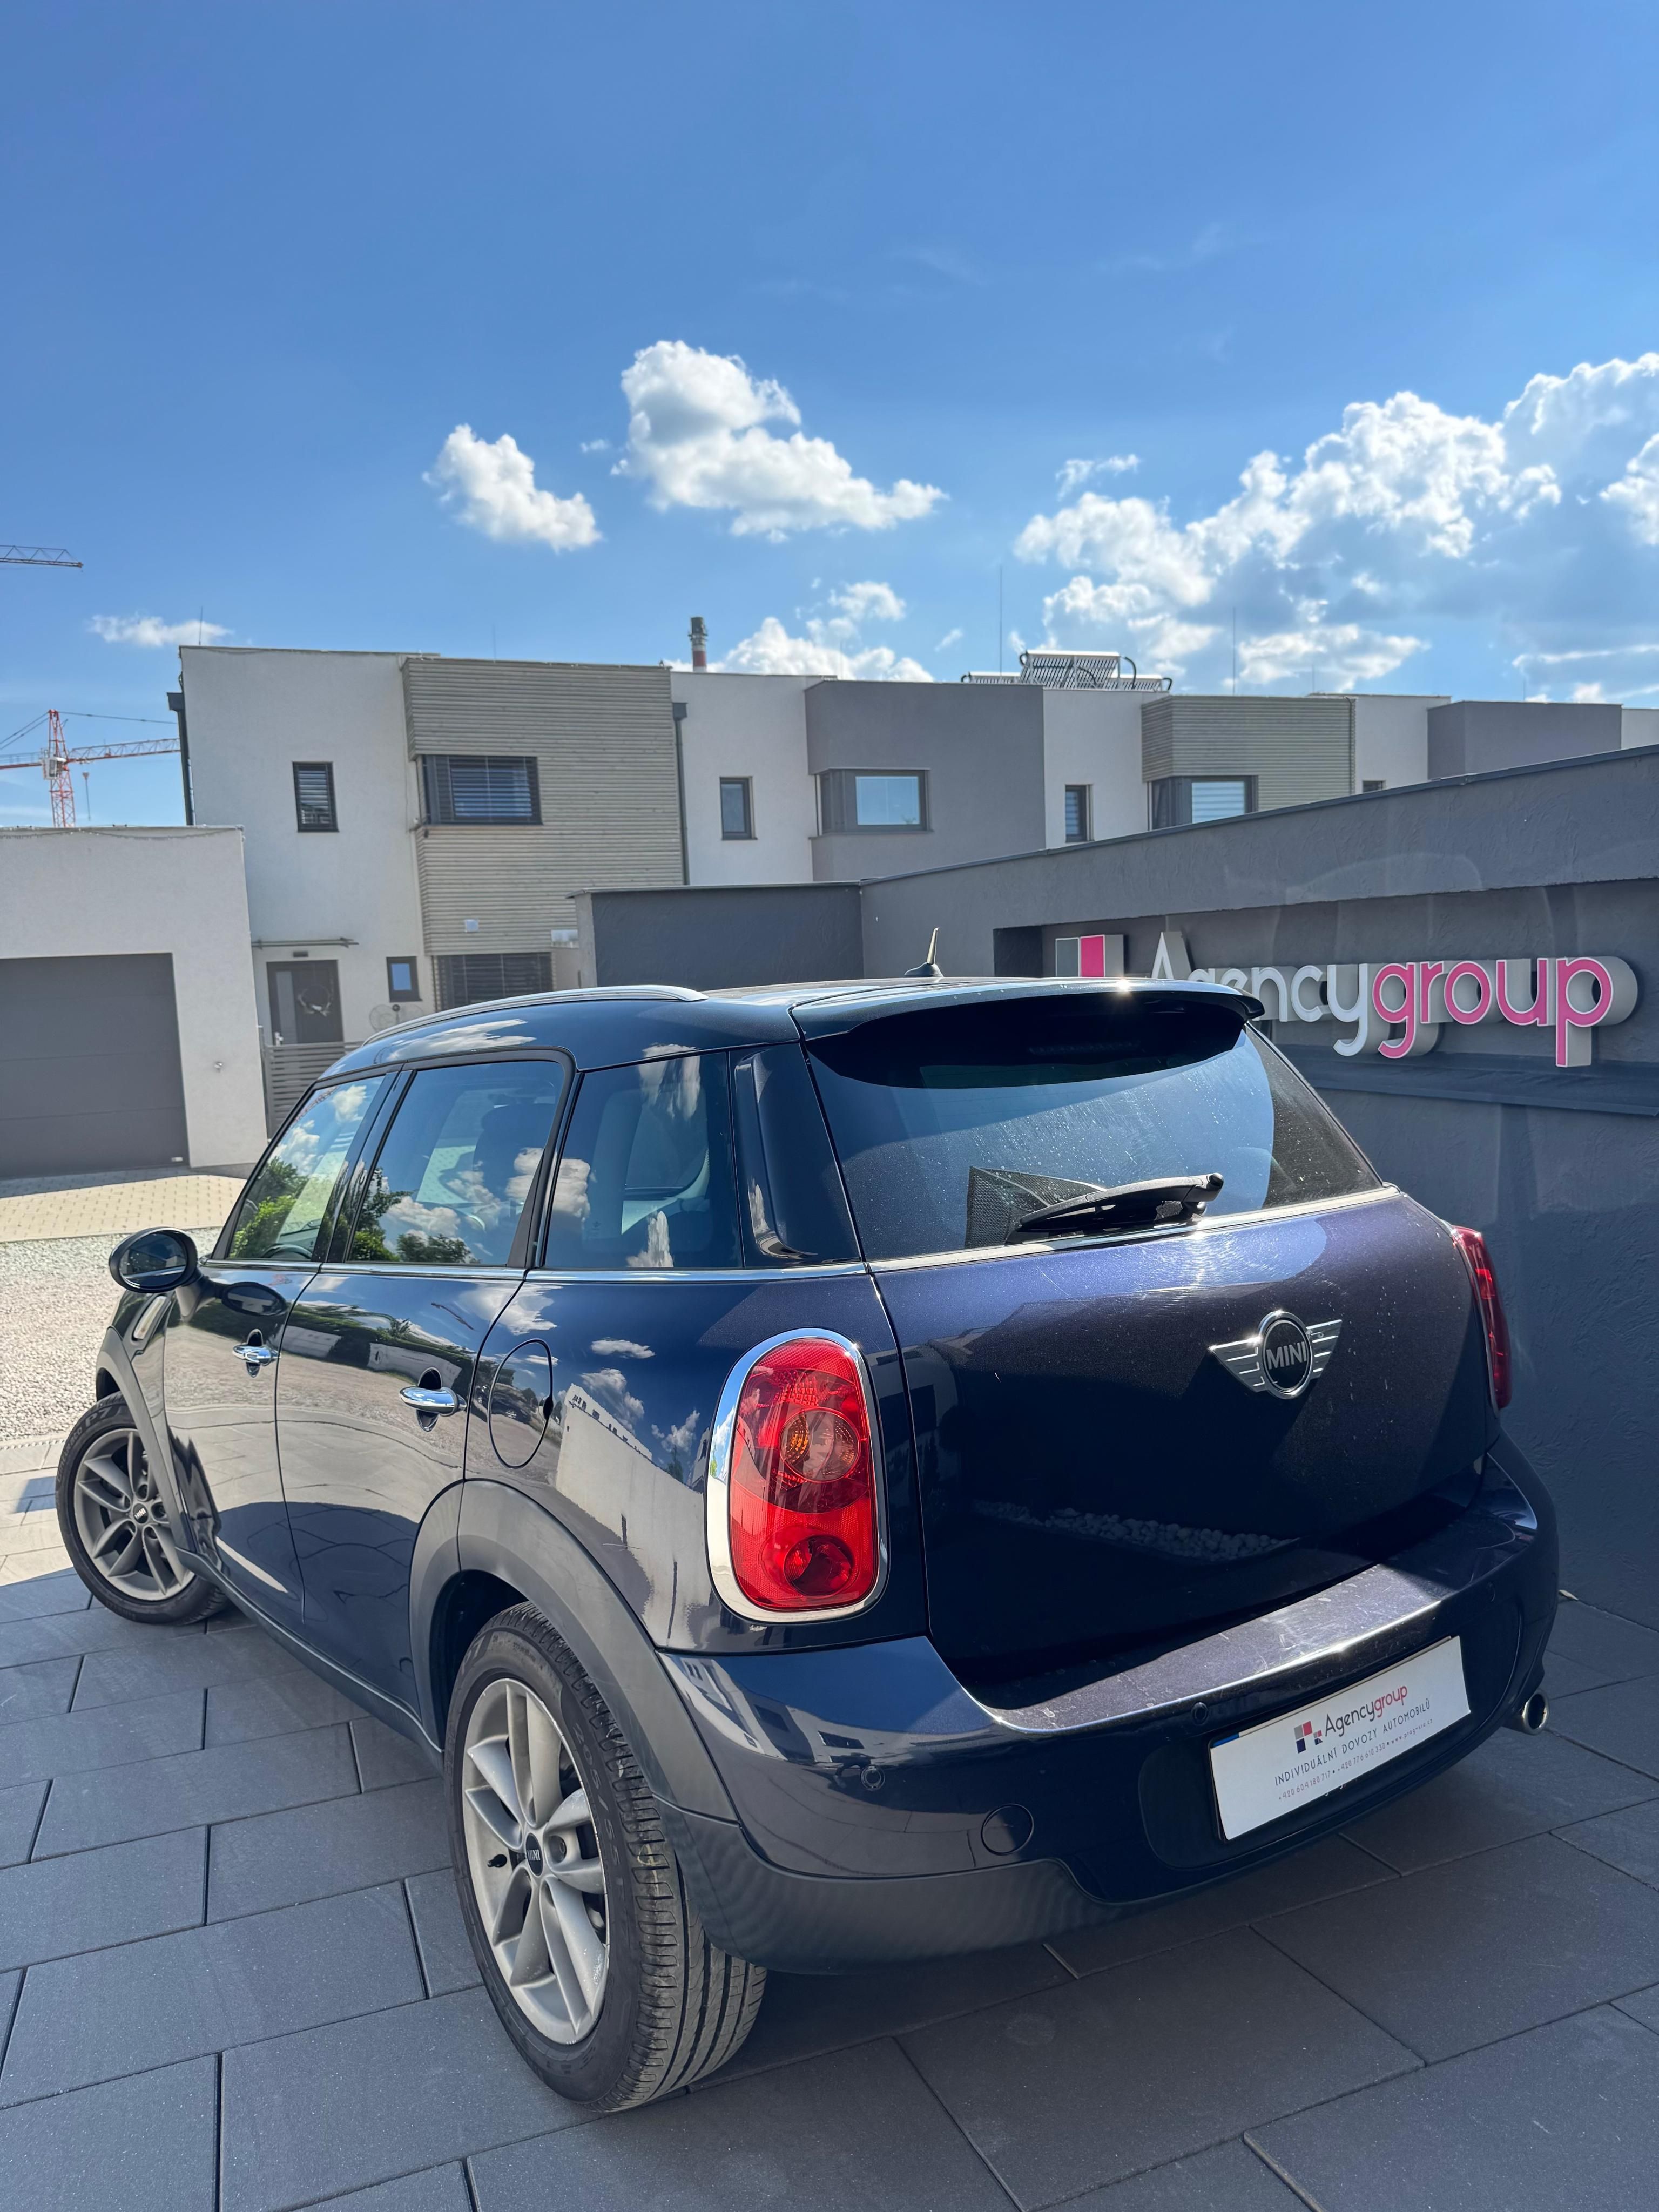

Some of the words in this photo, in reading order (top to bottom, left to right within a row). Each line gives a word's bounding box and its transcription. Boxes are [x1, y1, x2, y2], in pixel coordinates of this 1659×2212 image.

[1151, 931, 1615, 1068] Ancygroup
[1266, 1341, 1307, 1370] MINI
[85, 1406, 113, 1427] P7
[1325, 1685, 1408, 1737] Agencygroup
[1274, 1746, 1338, 1786] INDIVIDUÁLNÍ
[1342, 1728, 1377, 1754] DOVOZY
[1382, 1697, 1431, 1734] AUTOMOBILŮ
[1310, 1776, 1320, 1786] 180
[1321, 1770, 1331, 1781] 717
[1353, 1754, 1364, 1765] 776
[1365, 1748, 1374, 1758] 610
[527, 1849, 541, 1862] MINI
